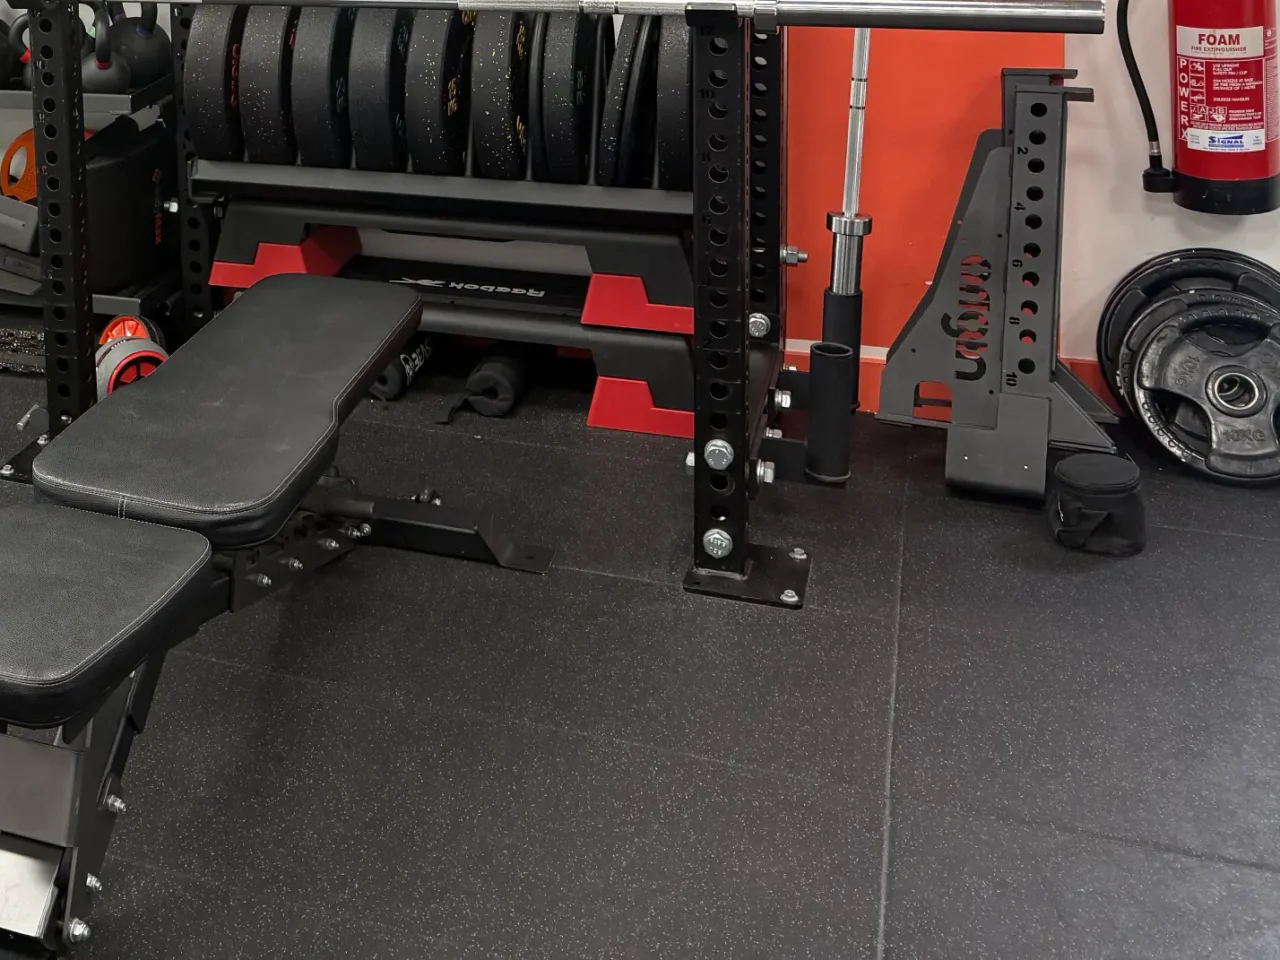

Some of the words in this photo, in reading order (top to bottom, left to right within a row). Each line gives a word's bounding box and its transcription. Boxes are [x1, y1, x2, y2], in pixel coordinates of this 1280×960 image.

[1198, 34, 1240, 46] FOAM
[1208, 135, 1244, 144] SIGNAL
[1017, 146, 1028, 155] 2
[1014, 202, 1026, 211] 4
[1012, 259, 1023, 268] 6
[449, 281, 546, 298] Reebok
[1008, 316, 1020, 325] 8
[1006, 371, 1017, 387] 10
